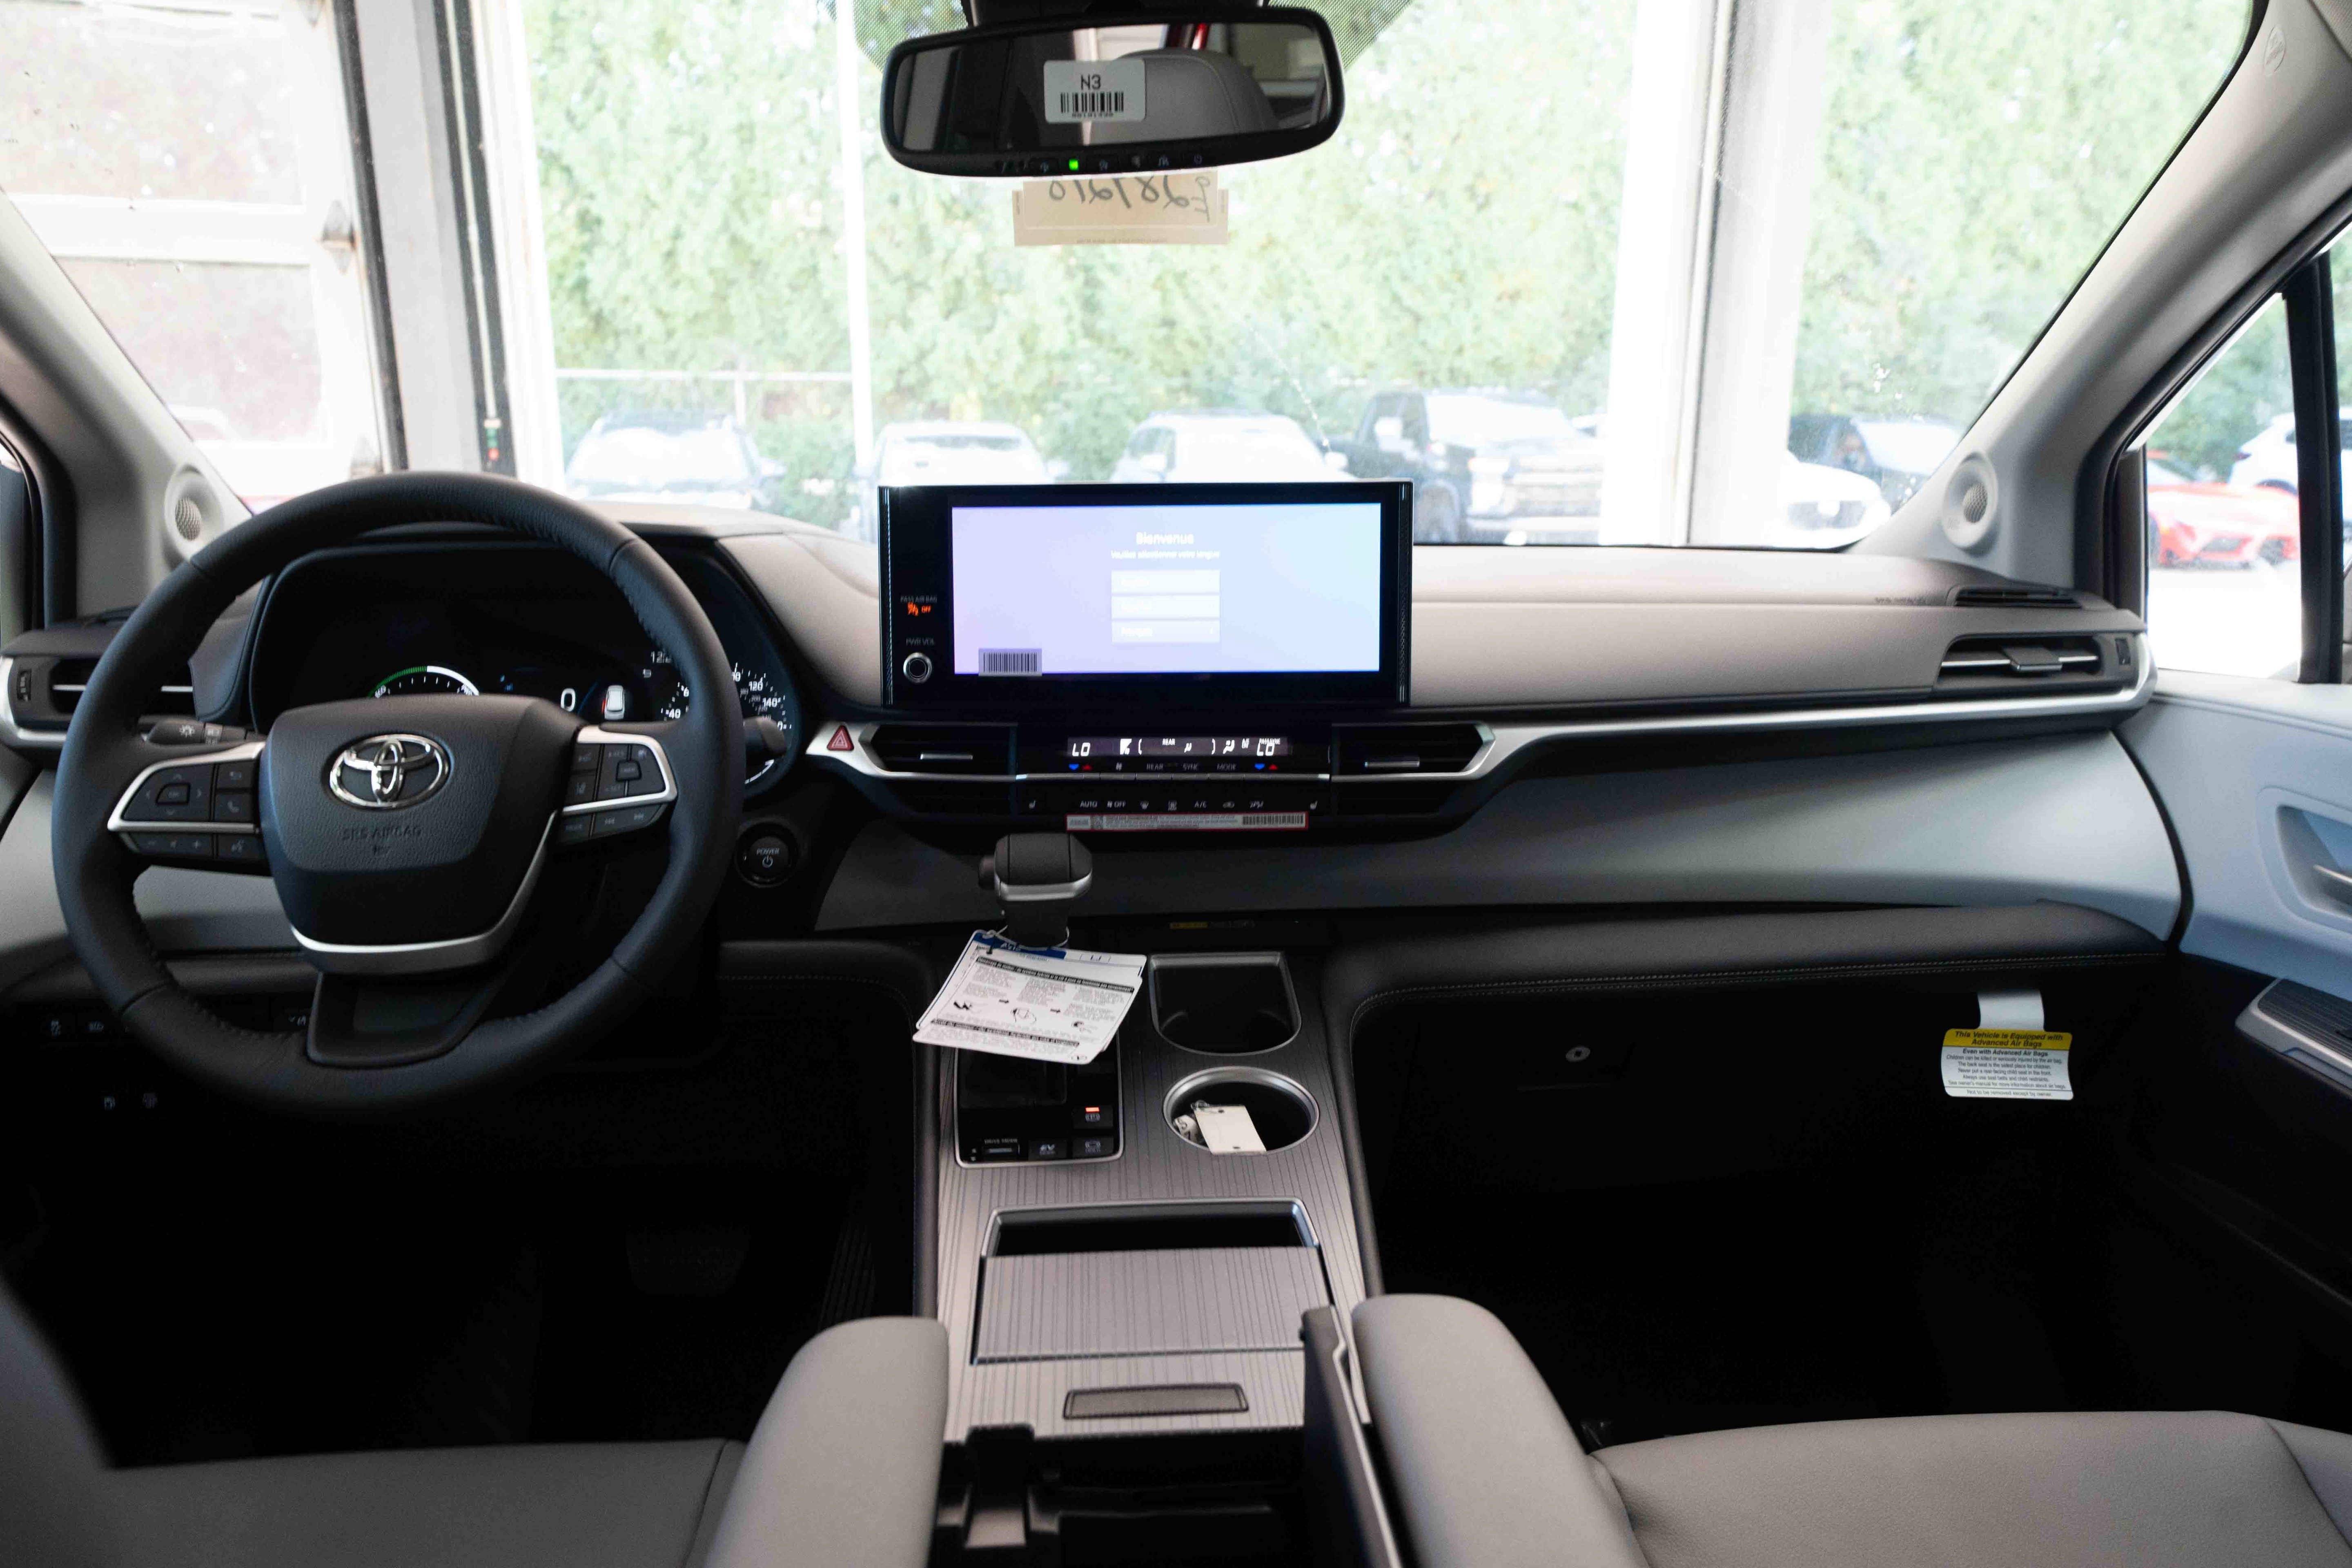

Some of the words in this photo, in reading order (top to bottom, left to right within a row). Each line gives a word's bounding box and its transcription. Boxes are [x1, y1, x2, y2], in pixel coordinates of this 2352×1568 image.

[1080, 74, 1101, 90] N3
[1136, 531, 1194, 545] Bienvenue
[748, 681, 763, 691] 120
[561, 688, 576, 712] 0
[763, 697, 777, 708] 140
[1072, 742, 1091, 757] LO
[756, 847, 780, 855] POWER
[2010, 1033, 2045, 1042] Equipped
[2023, 1040, 2042, 1049] Bags
